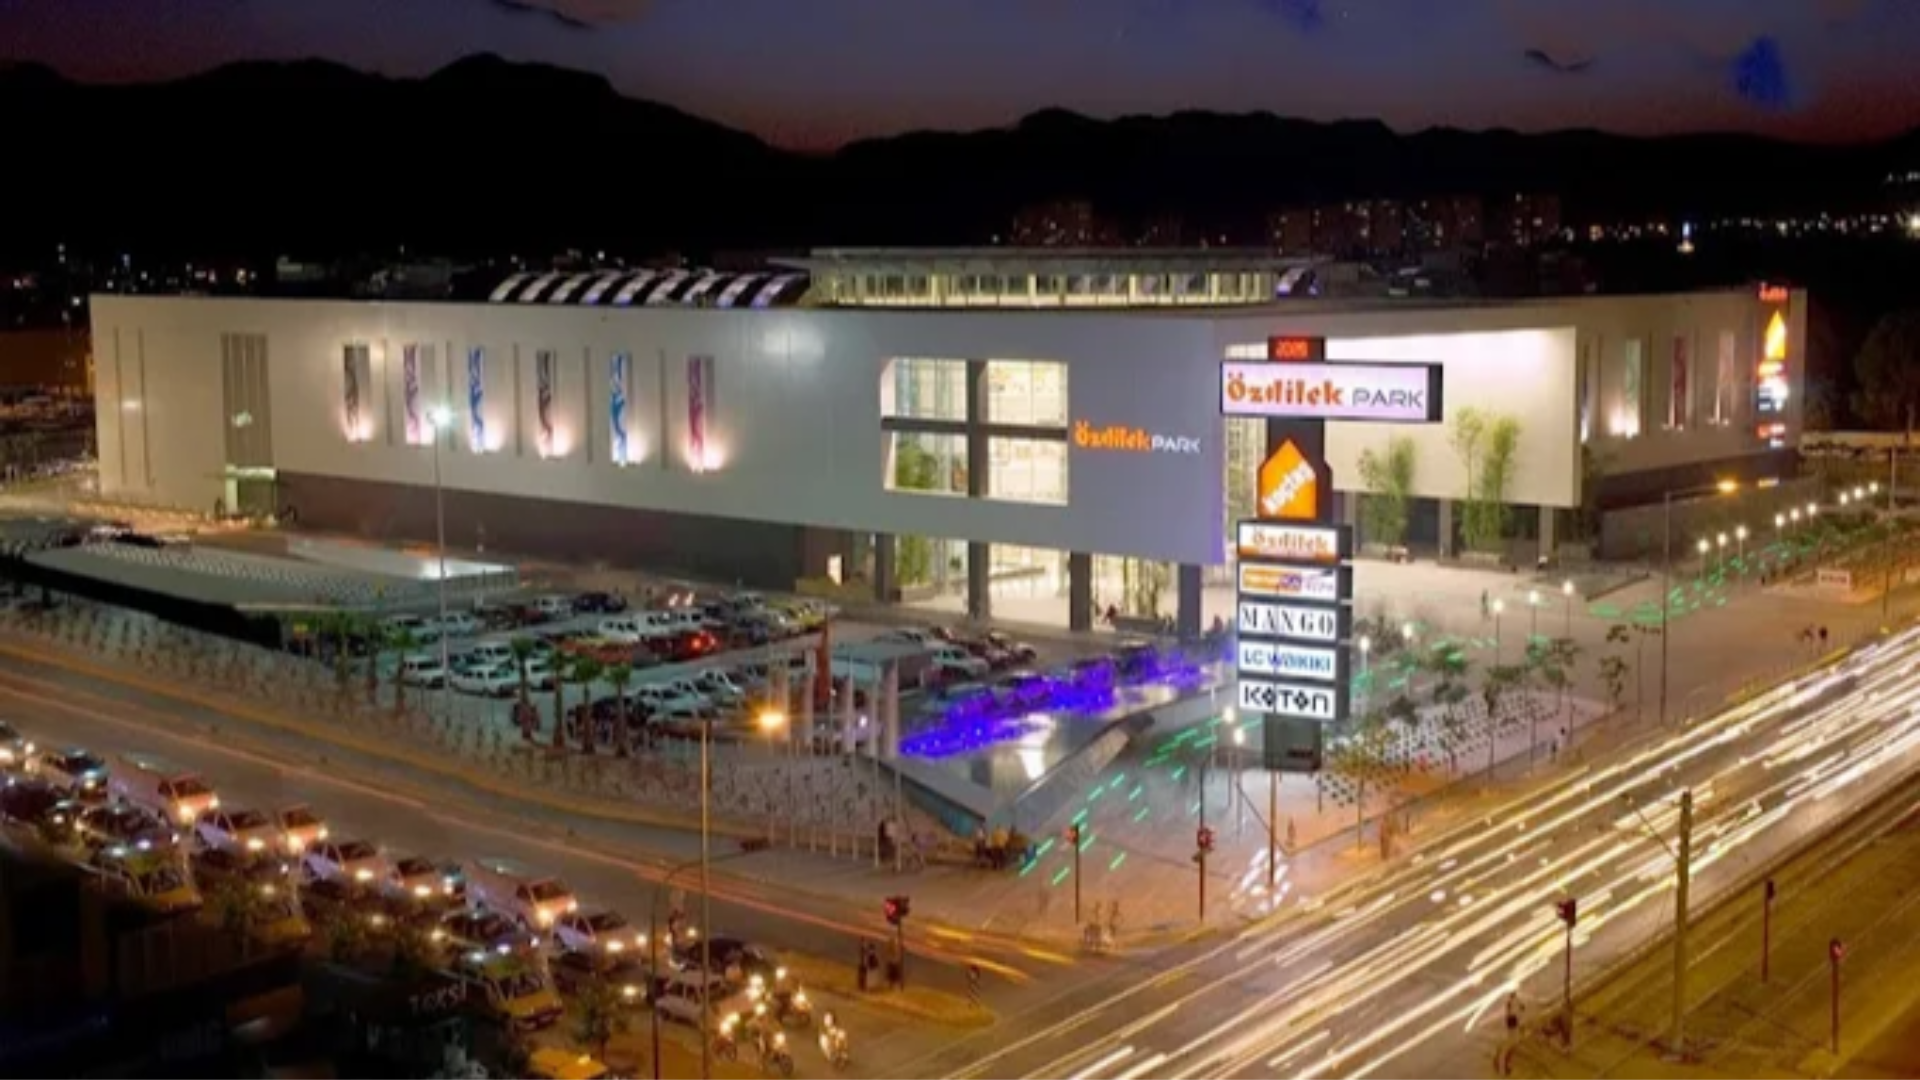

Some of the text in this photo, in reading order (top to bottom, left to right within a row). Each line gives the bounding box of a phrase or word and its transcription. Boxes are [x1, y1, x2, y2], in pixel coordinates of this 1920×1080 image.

[1227, 371, 1424, 408] Özdilek PARK
[1152, 435, 1200, 453] PARK
[1252, 526, 1328, 552] Özdilek
[1243, 607, 1333, 636] MANGO
[1245, 649, 1264, 665] LC
